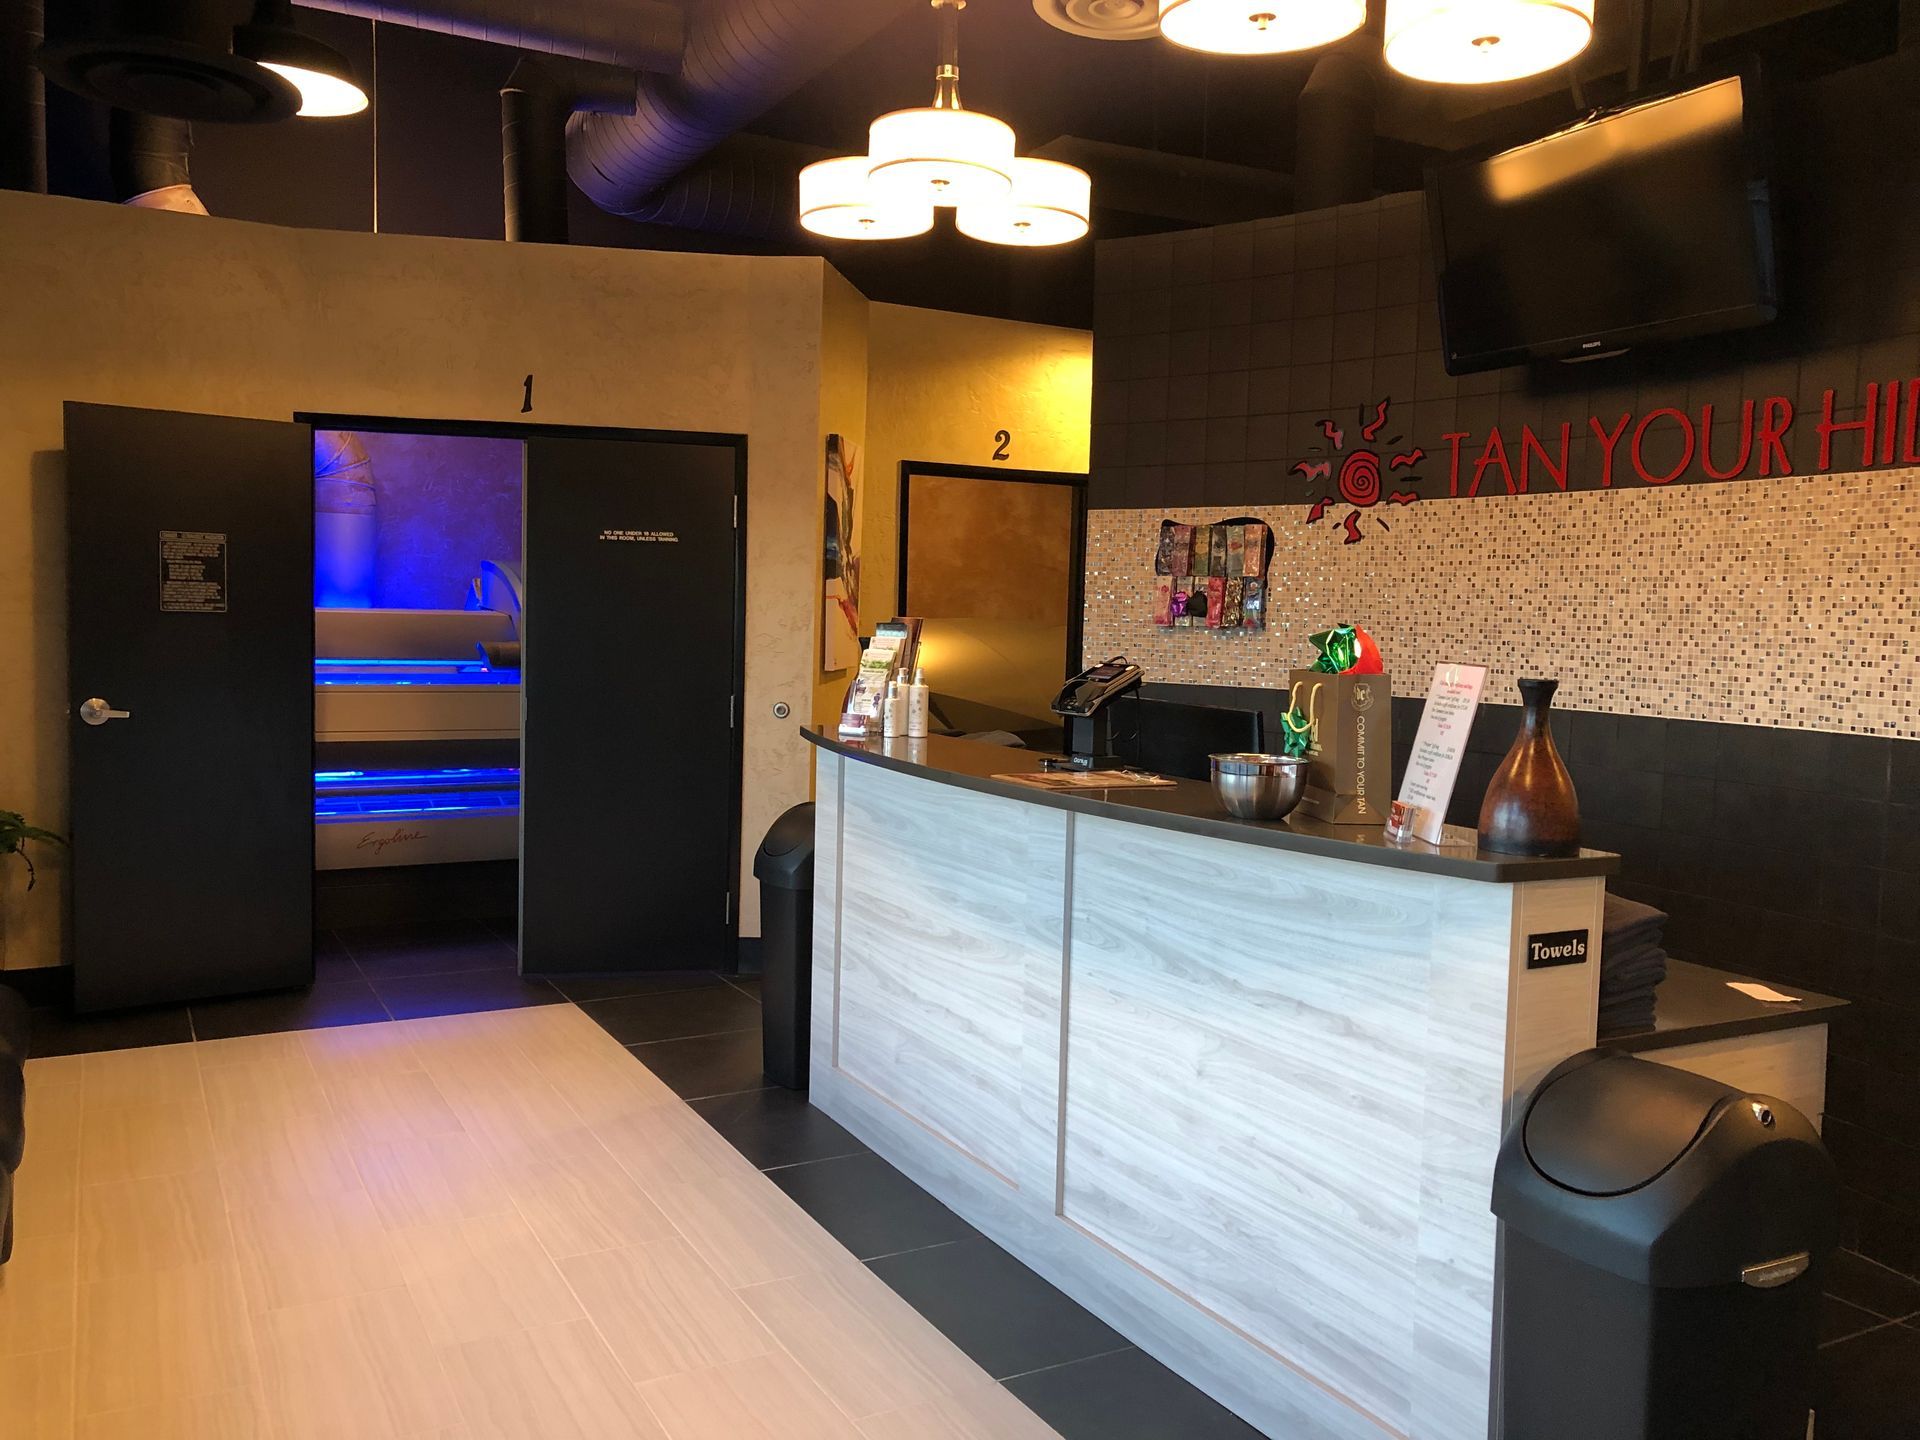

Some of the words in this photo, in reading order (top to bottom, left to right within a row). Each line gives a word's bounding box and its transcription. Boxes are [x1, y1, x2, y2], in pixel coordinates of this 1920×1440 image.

[521, 374, 533, 413] 1
[992, 429, 1010, 461] 2
[1442, 422, 1570, 497] TAN
[1589, 397, 1793, 487] YOUR
[1356, 715, 1366, 755] COMMIT
[1356, 757, 1366, 769] TO
[1356, 771, 1366, 796] YOUR
[1357, 798, 1367, 814] TAN
[1531, 939, 1585, 960] Towels
